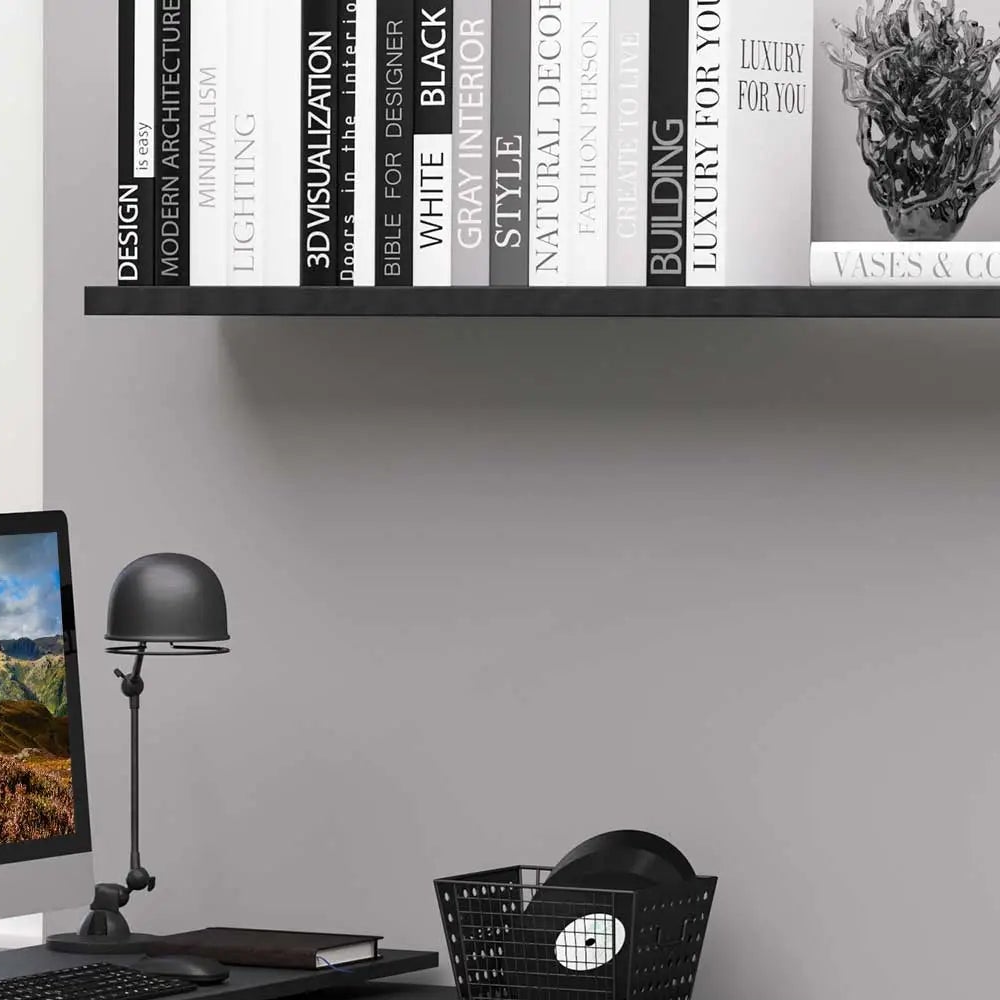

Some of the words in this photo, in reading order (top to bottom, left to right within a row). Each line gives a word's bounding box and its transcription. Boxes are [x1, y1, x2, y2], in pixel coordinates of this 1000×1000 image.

[161, 0, 181, 168] ARCHITECTURE
[386, 20, 403, 137] DESIGNER
[421, 8, 446, 106] BLACK
[458, 18, 485, 158] INTERIOR
[580, 21, 598, 115] PERSON
[619, 33, 640, 88] LIVE
[694, 64, 720, 128] FOR
[738, 80, 770, 113] FOR
[774, 83, 807, 114] YOU
[740, 39, 805, 74] LUXURY
[137, 122, 152, 155] easy
[198, 67, 217, 208] MINIMALISM
[308, 31, 332, 225] VISUALIZATION
[341, 115, 356, 152] the
[618, 98, 639, 133] TO
[136, 160, 149, 170] is
[233, 113, 256, 272] LIGHTING
[341, 172, 355, 193] in
[385, 152, 402, 199] FOR
[419, 152, 444, 248] WHITE
[457, 168, 483, 249] GRAY
[494, 135, 522, 248] STYLE
[535, 118, 561, 273] NATURAL
[578, 126, 597, 234] FASHION
[617, 138, 638, 239] CREATE
[651, 119, 684, 275] BUILDING
[692, 140, 718, 272] LUXURY
[118, 184, 138, 281] DESIGN
[161, 176, 181, 276] MODERN
[307, 232, 331, 268] 3D
[340, 214, 355, 281] Doors
[385, 214, 402, 276] BIBLE
[833, 251, 922, 279] VASES
[932, 251, 954, 279] &
